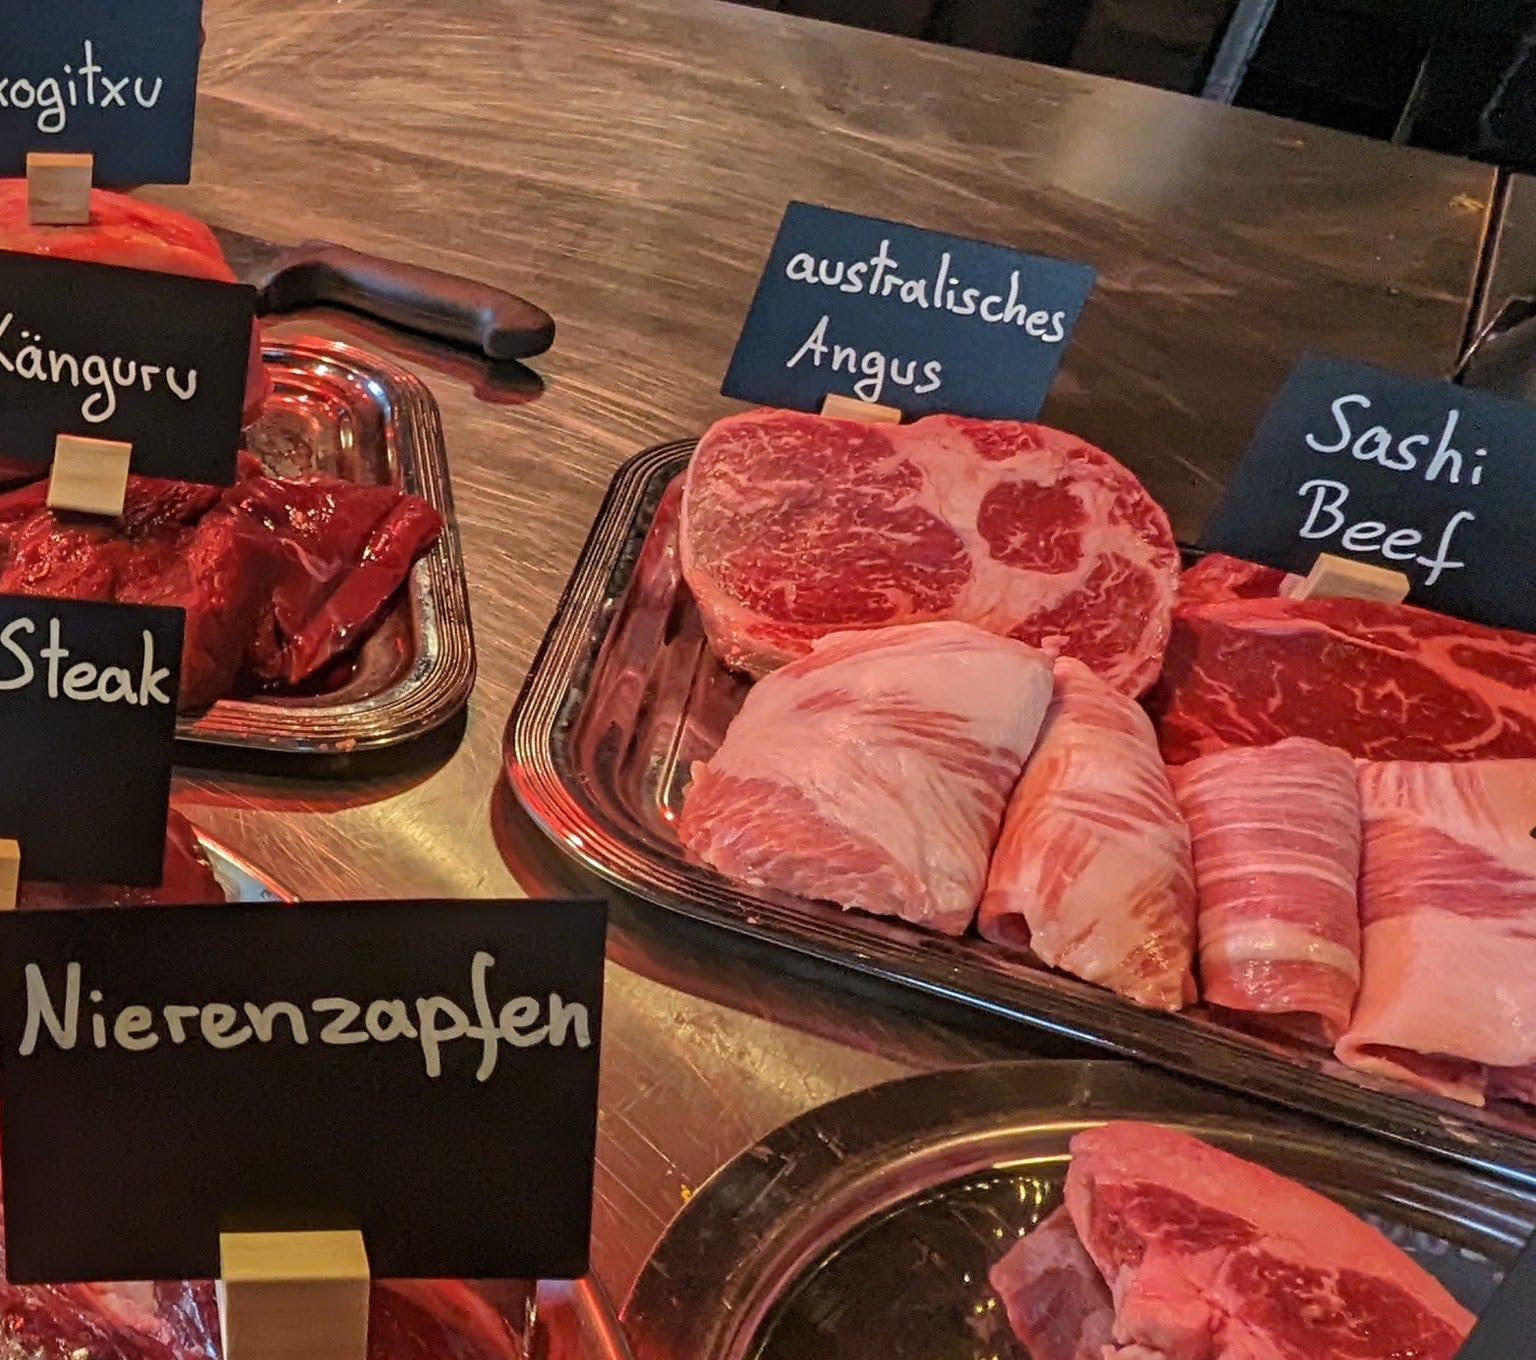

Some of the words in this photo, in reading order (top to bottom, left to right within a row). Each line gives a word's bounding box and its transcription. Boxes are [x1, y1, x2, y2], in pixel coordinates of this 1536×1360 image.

[786, 239, 1066, 343] australisches
[786, 315, 942, 402] Angus
[1304, 394, 1487, 487] Sashi
[1296, 479, 1477, 586] Beef
[18, 952, 591, 1082] Nierenzapfen
